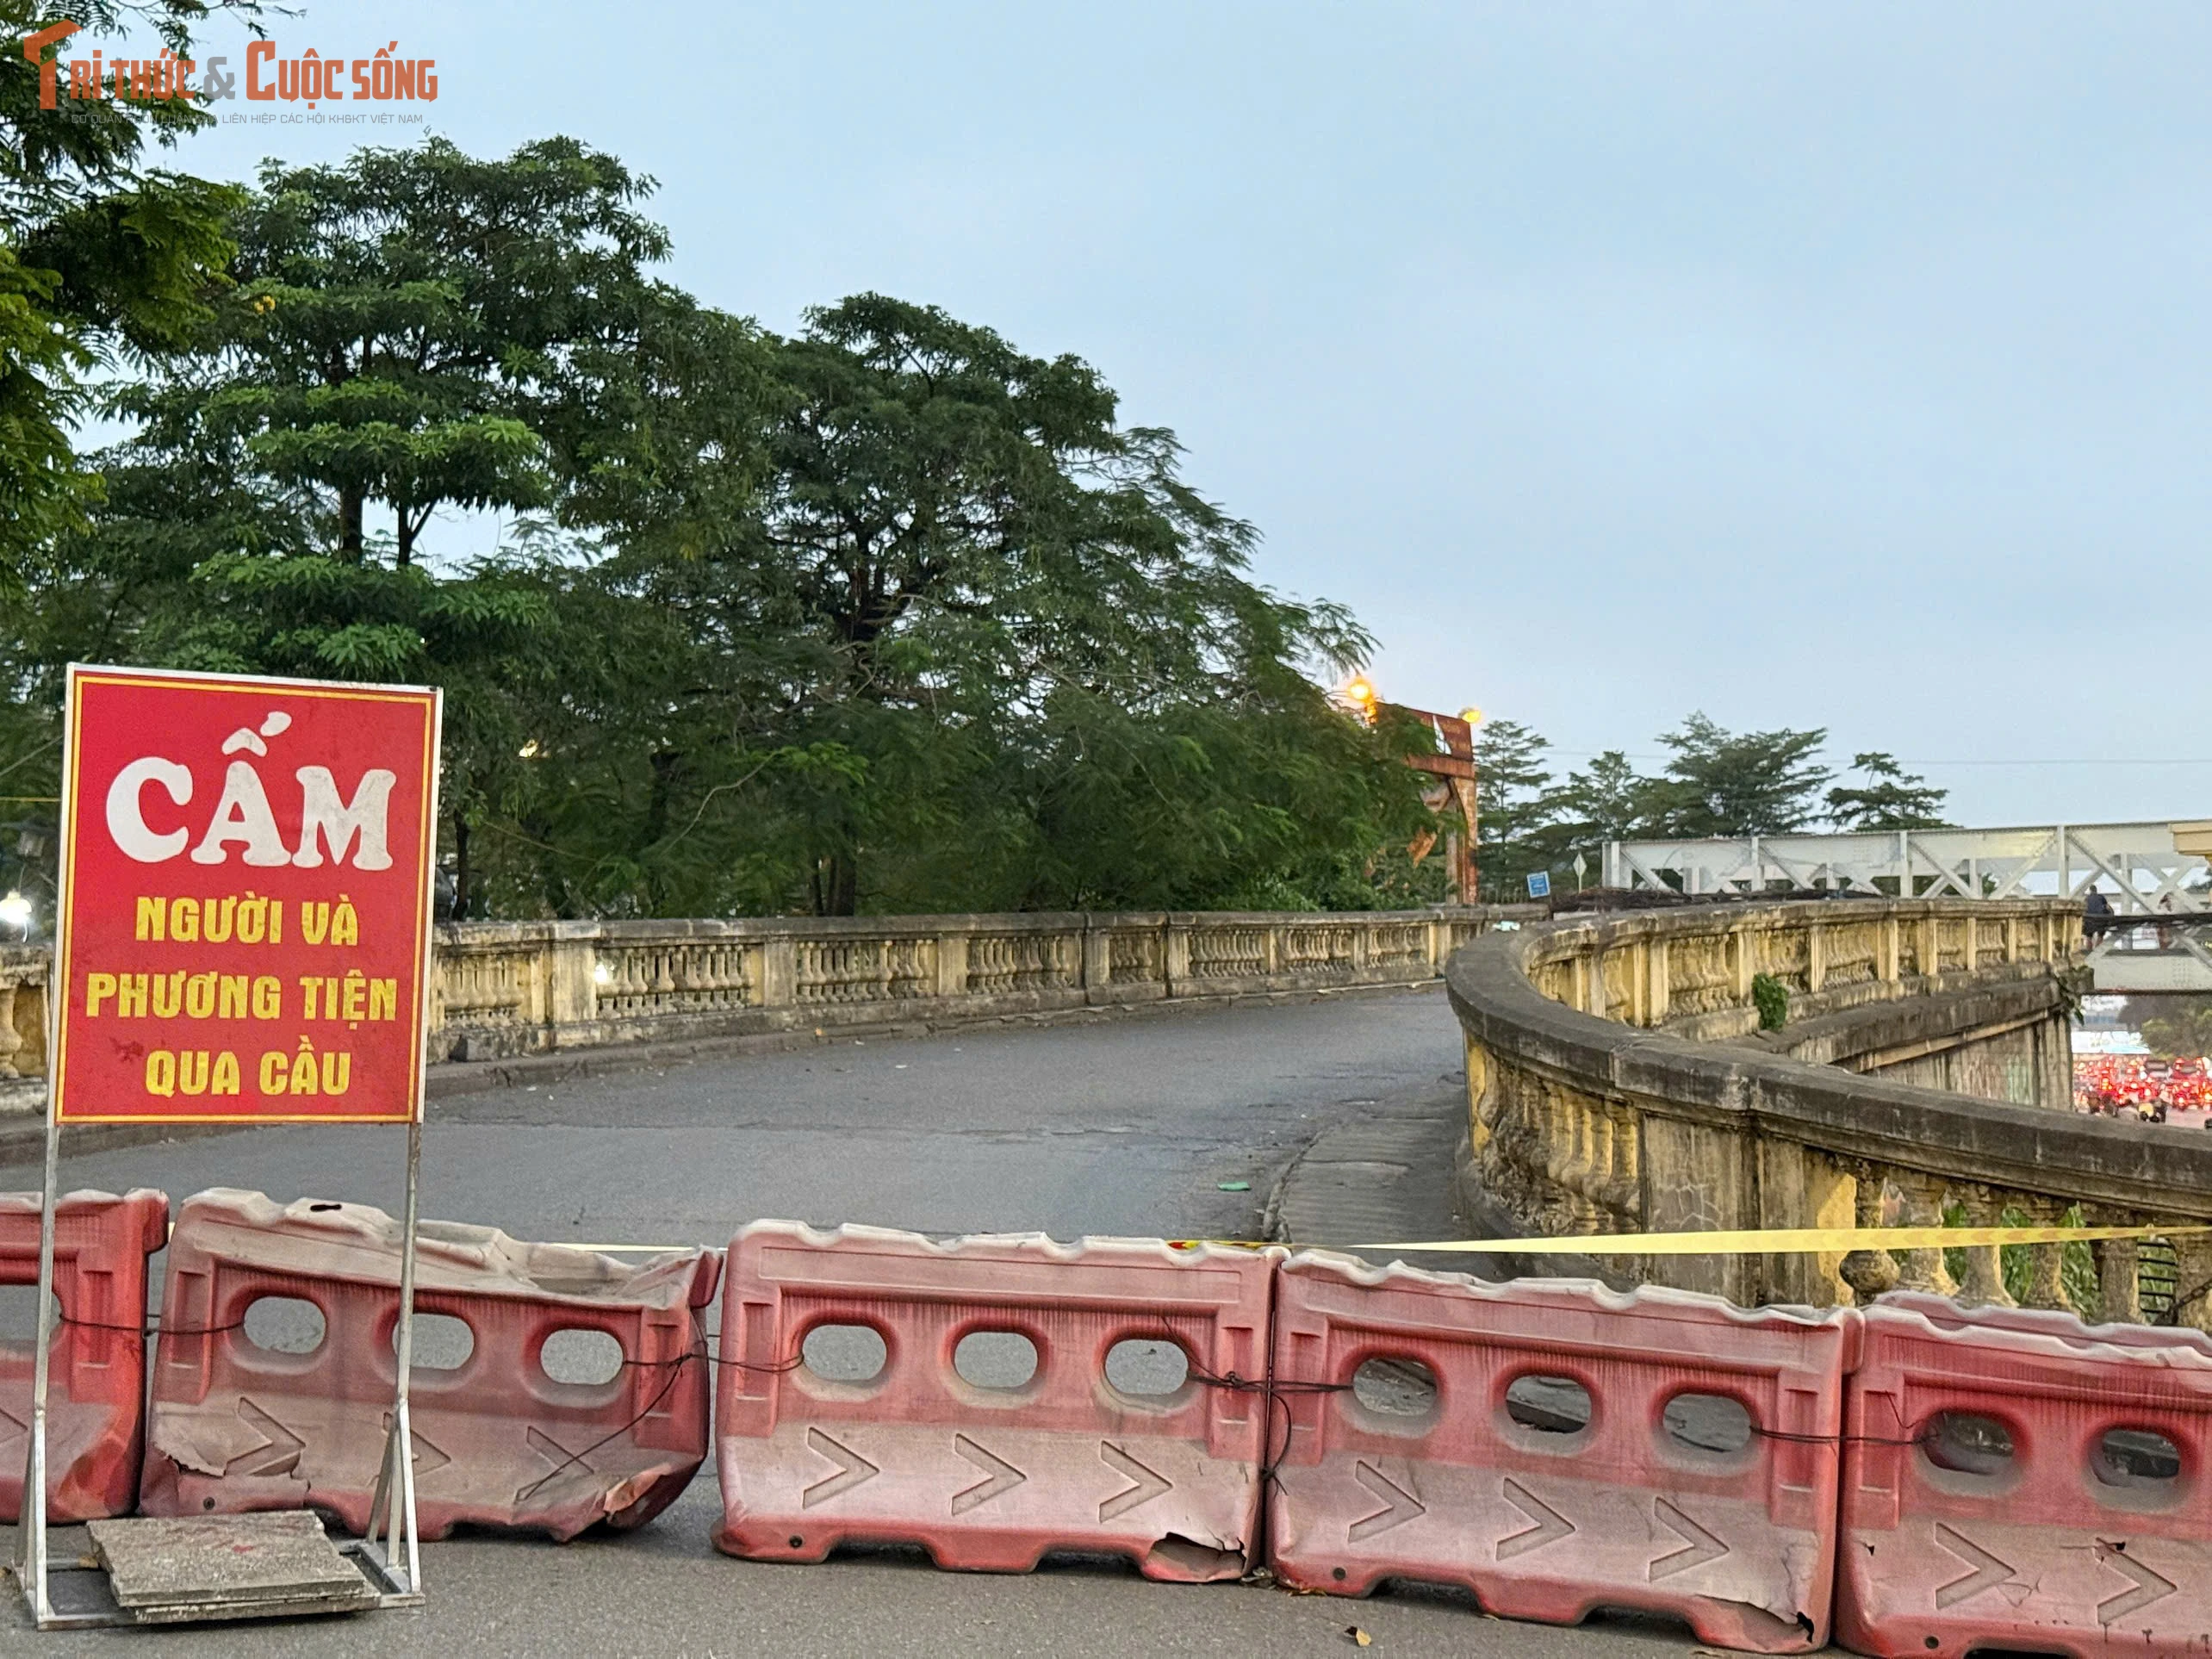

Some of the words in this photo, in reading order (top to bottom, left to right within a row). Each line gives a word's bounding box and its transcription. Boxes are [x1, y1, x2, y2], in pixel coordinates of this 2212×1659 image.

[106, 711, 397, 871] CẤM
[135, 891, 283, 944] NGƯỜI
[301, 893, 359, 946] VÀ
[86, 970, 282, 1020] PHƯƠNG
[299, 969, 398, 1030] TIỆN
[145, 1050, 241, 1098] QUA
[259, 1035, 351, 1096] CẦU
